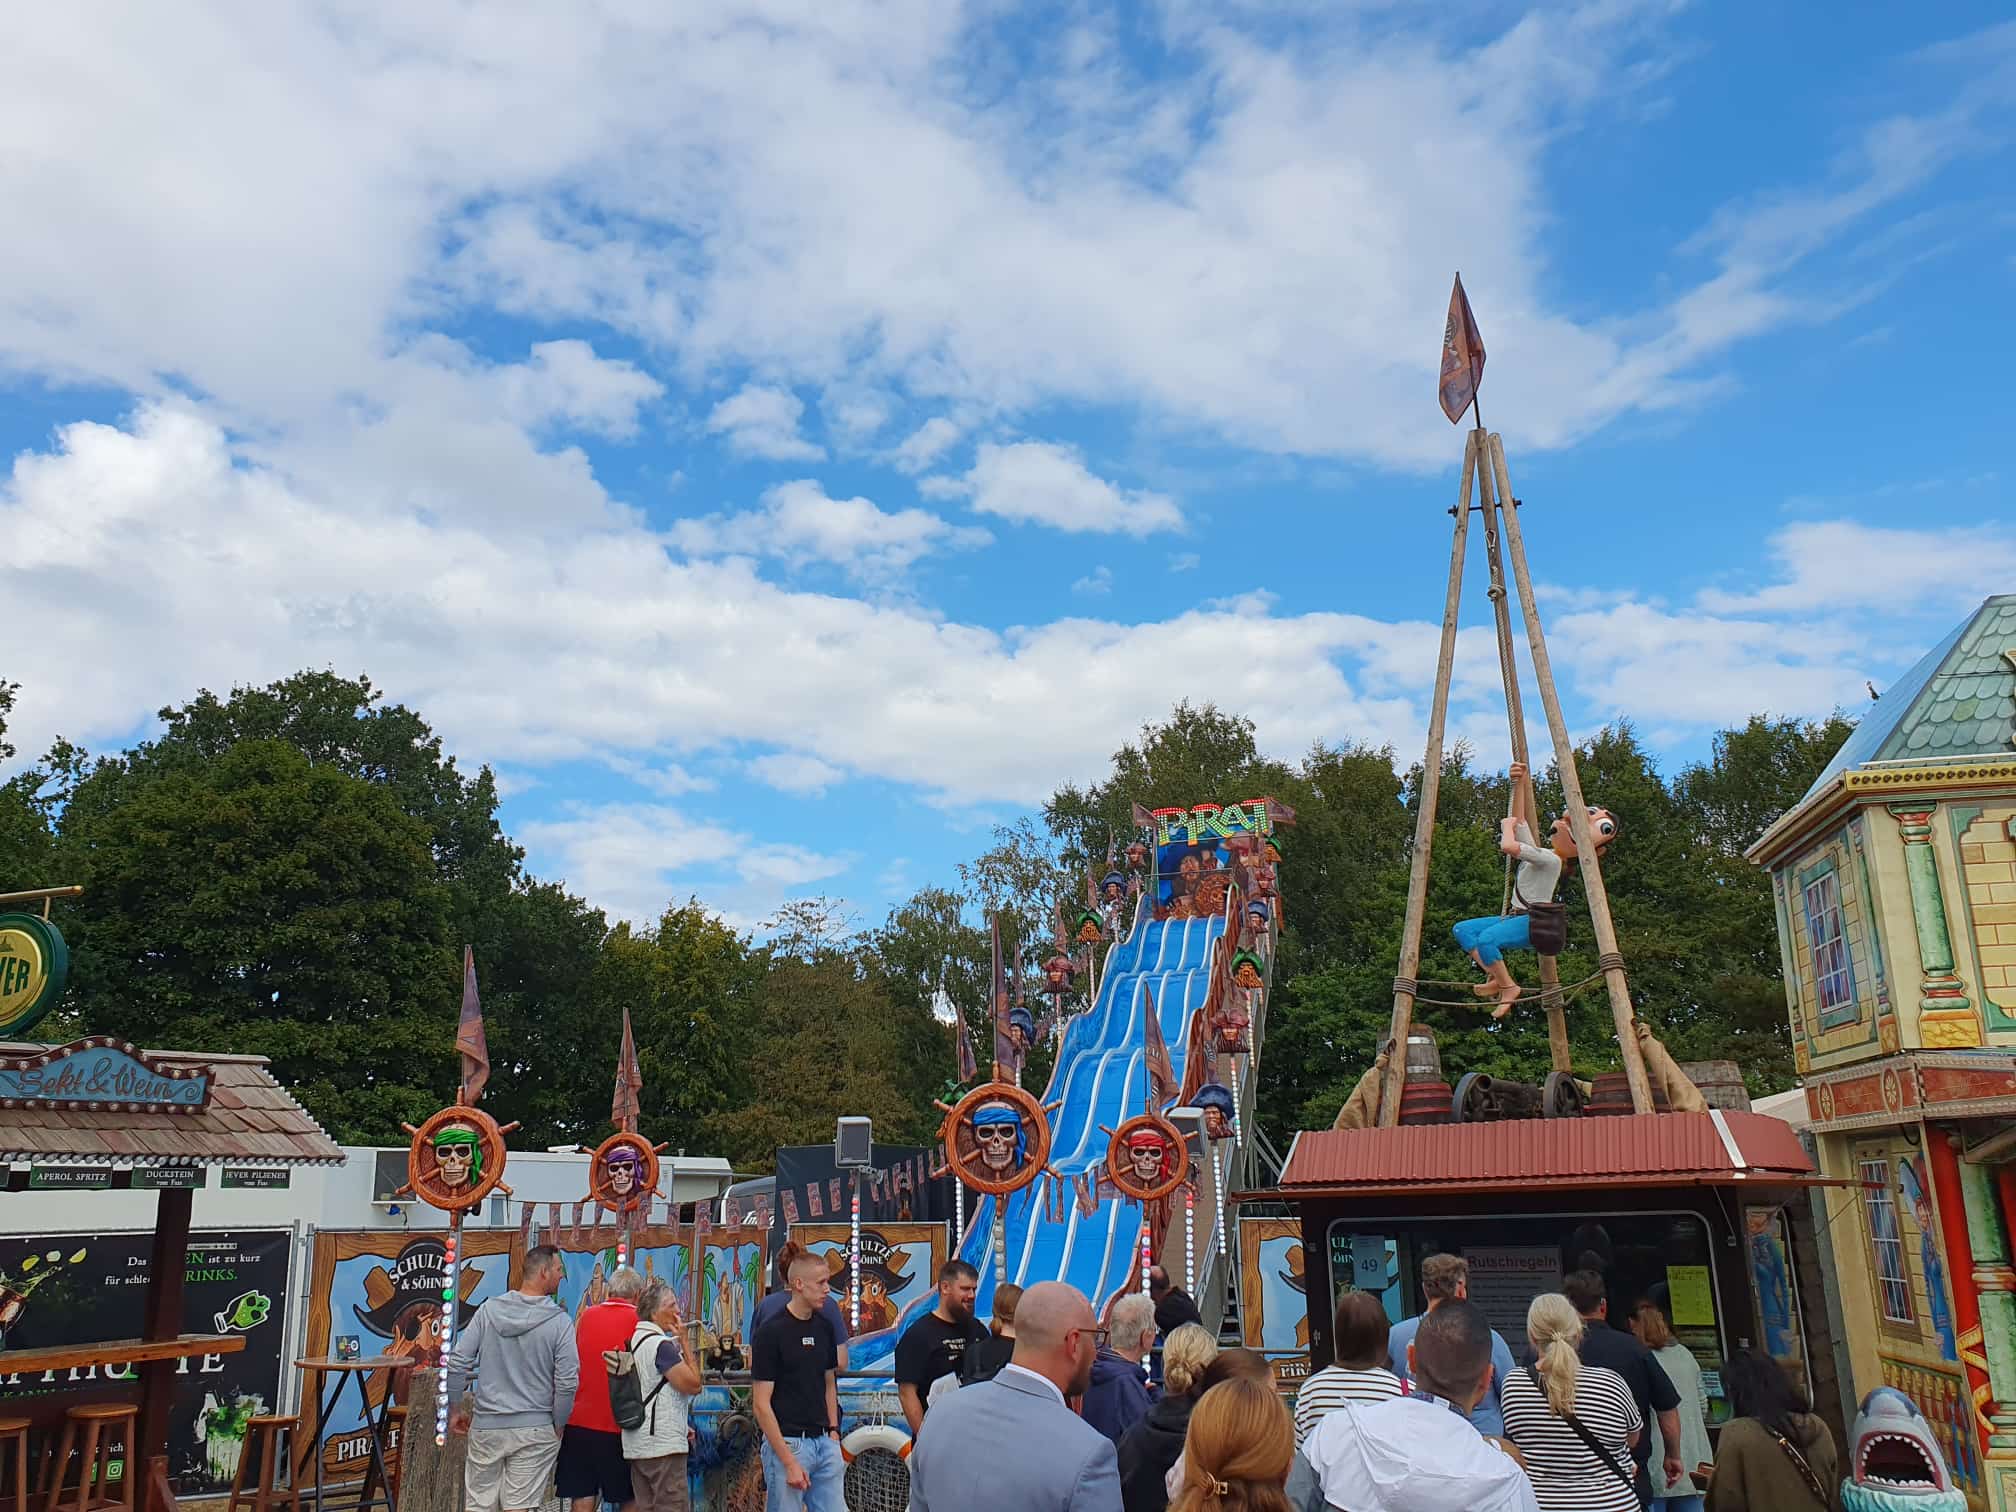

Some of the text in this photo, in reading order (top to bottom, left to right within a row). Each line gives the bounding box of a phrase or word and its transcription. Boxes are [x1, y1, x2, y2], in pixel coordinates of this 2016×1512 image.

[19, 1057, 173, 1098] Sekt & Wein
[37, 1172, 107, 1181] APEROL SPRITZ
[146, 1170, 194, 1178] DUCKSTEIN
[840, 1240, 891, 1260] SCULTZE
[128, 1256, 147, 1266] Das
[208, 1255, 220, 1264] ist
[240, 1253, 261, 1263] kurz
[1361, 1259, 1379, 1273] 49
[389, 1253, 448, 1285] SCHULT
[105, 1275, 121, 1285] für
[185, 1269, 238, 1282] RINKS.
[401, 1278, 410, 1290] &
